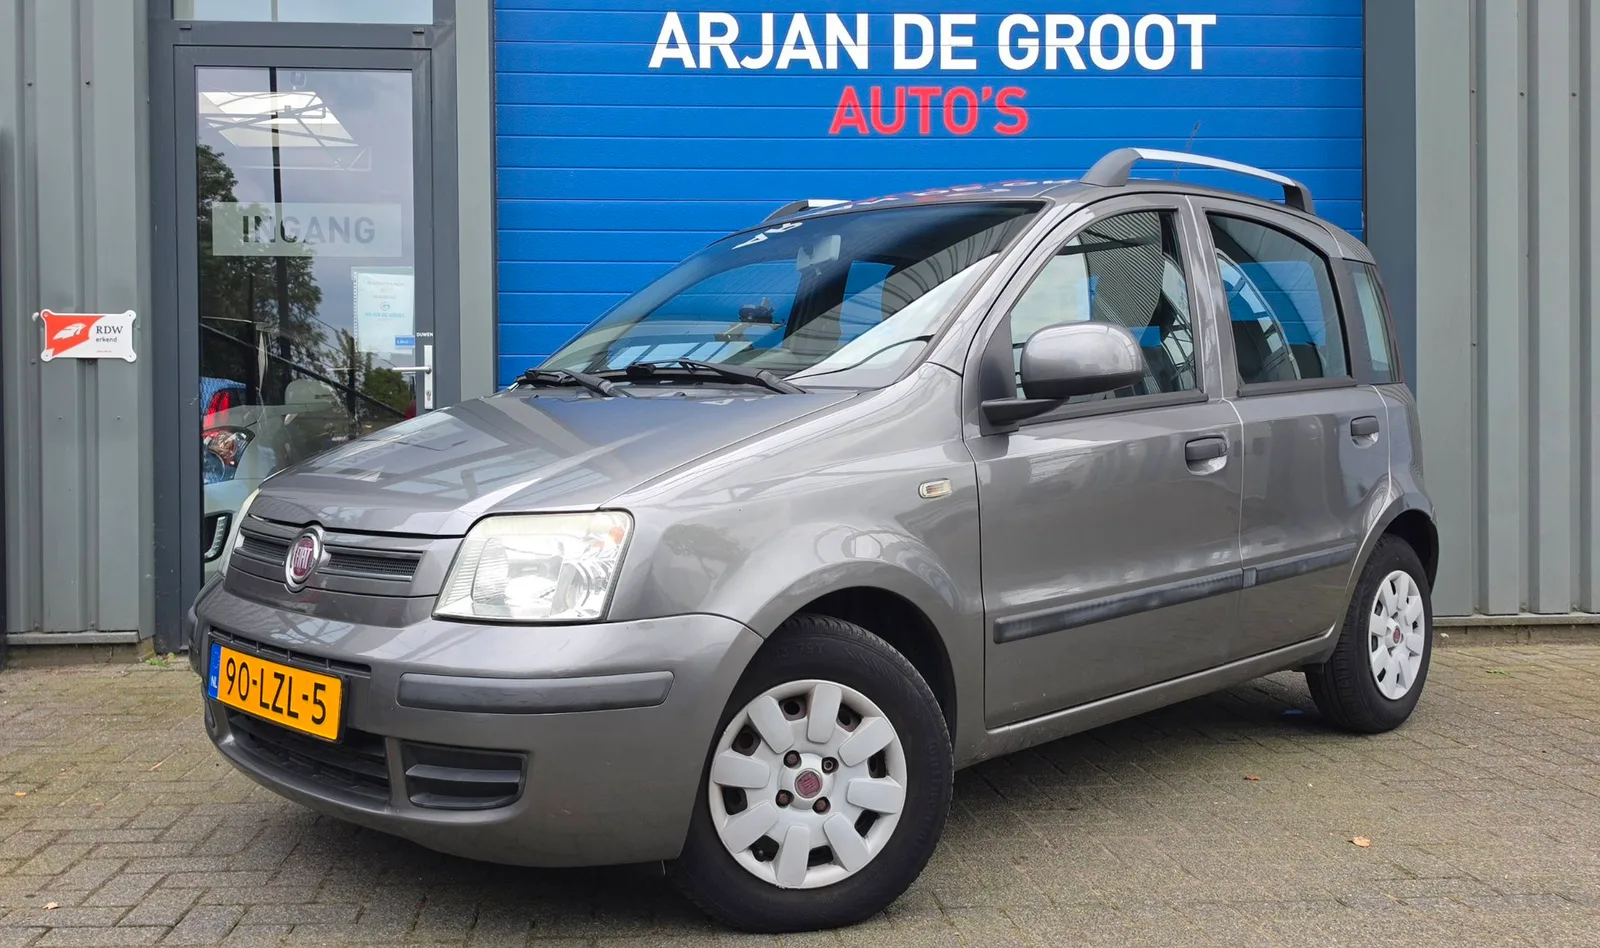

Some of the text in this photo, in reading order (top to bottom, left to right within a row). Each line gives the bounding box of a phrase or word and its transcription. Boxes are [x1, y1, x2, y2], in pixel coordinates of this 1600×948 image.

[649, 12, 1216, 70] ARJAN DE GROOT
[830, 86, 1028, 135] AUTO'S
[242, 215, 375, 243] INGANG
[96, 325, 123, 334] RDW
[293, 546, 313, 569] FIAT
[210, 674, 218, 689] NL
[226, 657, 327, 726] 90-LZL-5
